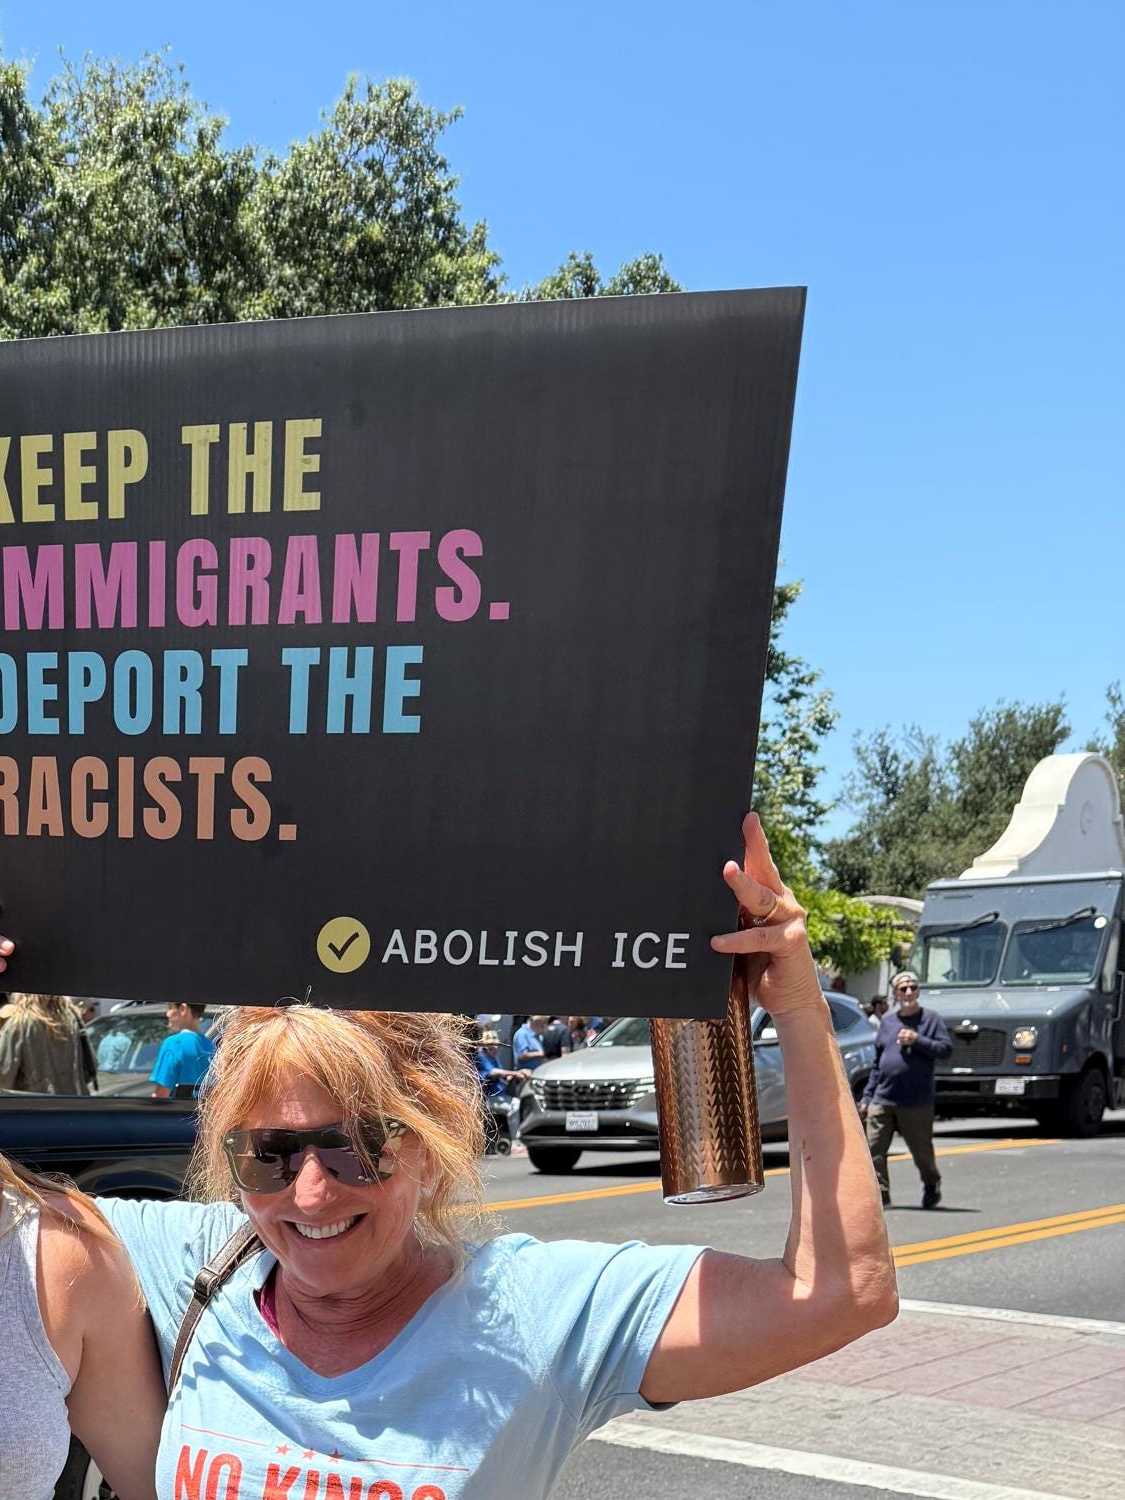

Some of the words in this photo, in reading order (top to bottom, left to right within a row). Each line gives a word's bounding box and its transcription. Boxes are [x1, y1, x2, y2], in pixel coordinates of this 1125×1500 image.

[181, 418, 323, 515] THE
[282, 644, 424, 734] THE
[381, 928, 585, 968] ABOLISH
[611, 930, 691, 969] ICE
